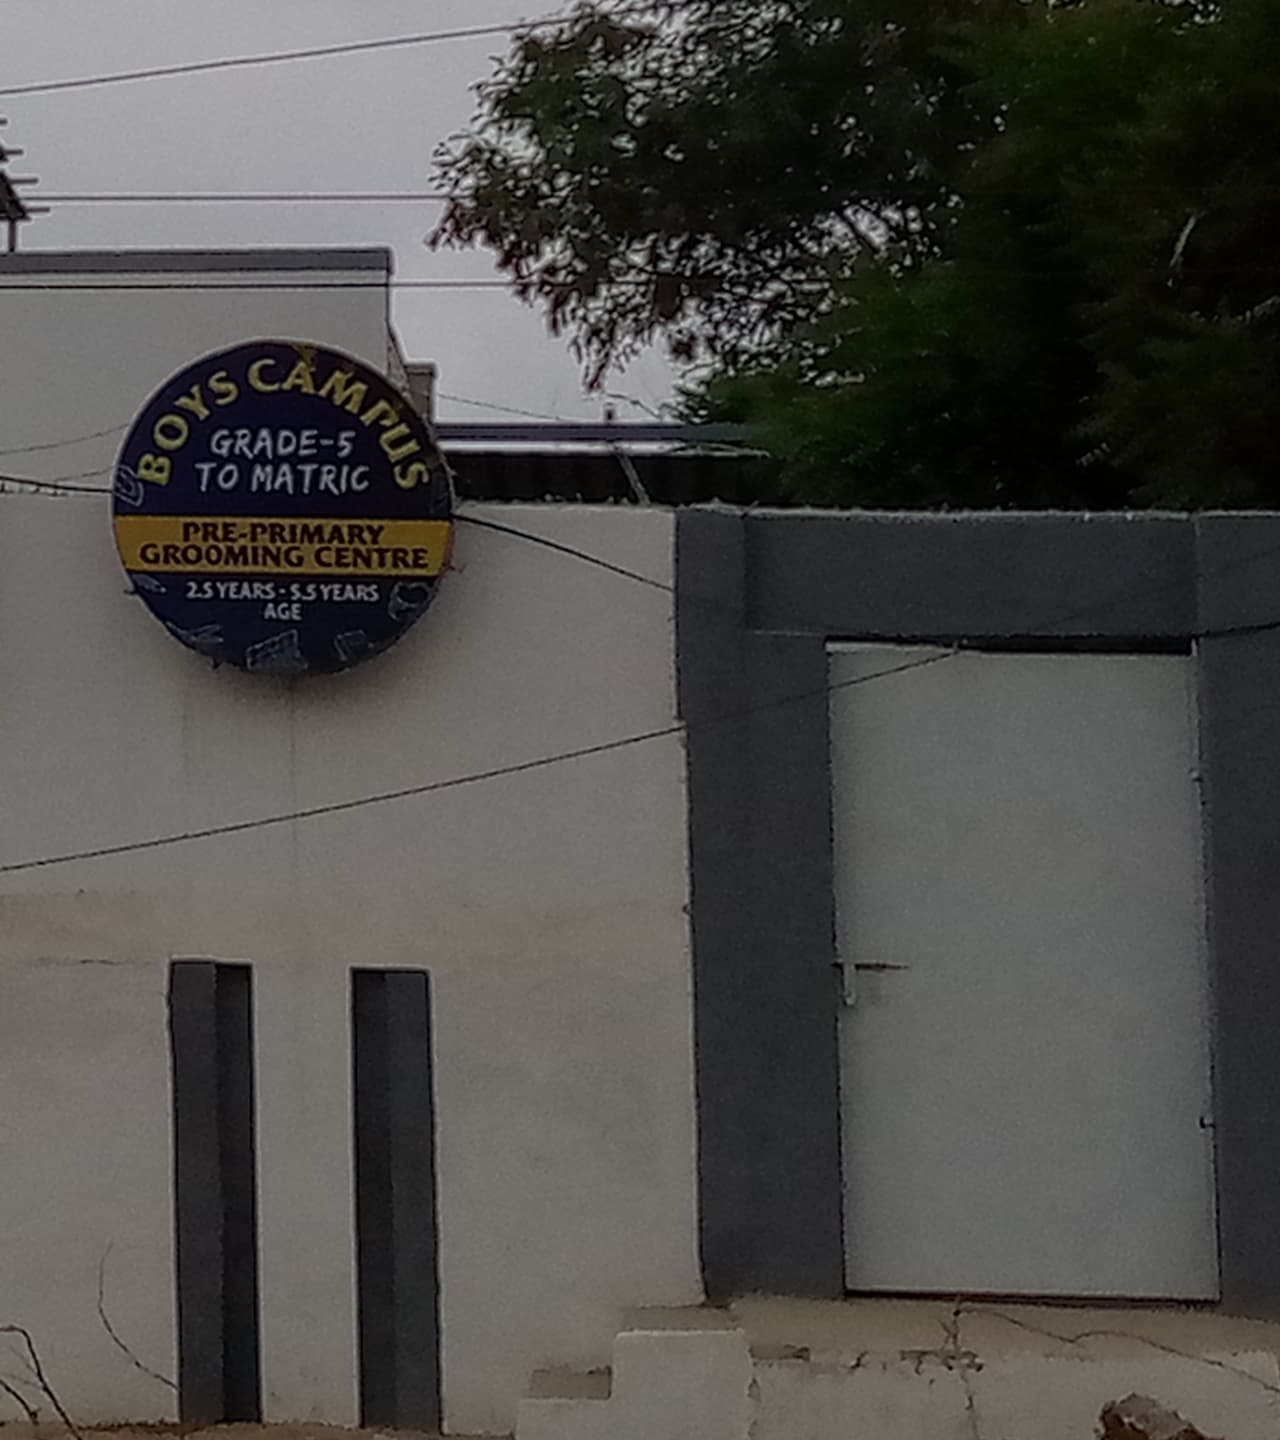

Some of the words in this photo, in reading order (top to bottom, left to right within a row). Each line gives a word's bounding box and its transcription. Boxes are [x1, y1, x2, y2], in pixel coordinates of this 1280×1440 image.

[138, 370, 240, 486] BOYS
[247, 358, 430, 490] CAMPUS
[209, 427, 357, 460] GRADE-5
[194, 463, 239, 493] TO
[250, 463, 370, 495] MATRIC
[181, 521, 385, 546] PRE-PRIMARY
[139, 544, 305, 568] GROOMING
[313, 545, 429, 569] CENTRE
[215, 581, 277, 601] YEARS
[320, 583, 380, 603] YEARS
[263, 602, 303, 621] AGE
